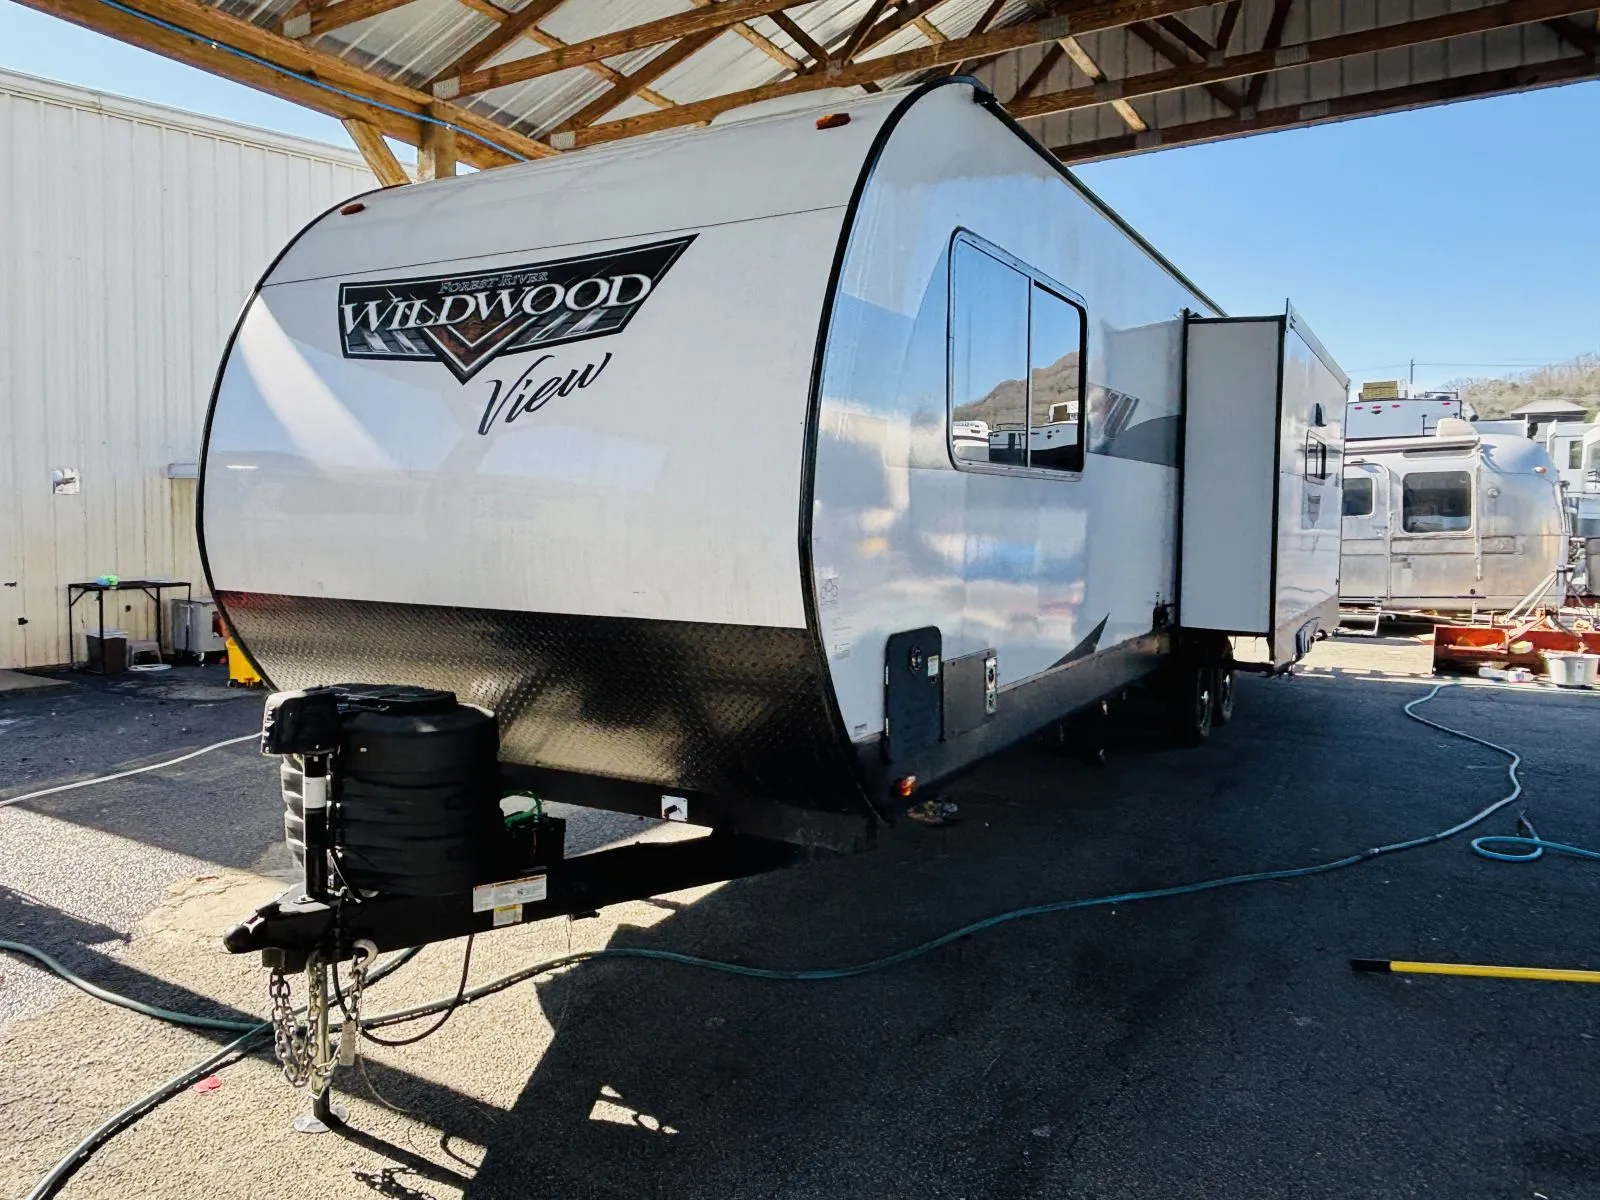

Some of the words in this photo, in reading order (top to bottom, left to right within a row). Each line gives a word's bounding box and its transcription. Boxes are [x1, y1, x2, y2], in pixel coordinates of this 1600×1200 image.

[340, 273, 652, 336] WILDWOOD
[437, 277, 499, 294] FOREST
[497, 271, 549, 287] RIVER
[477, 351, 613, 436] View
